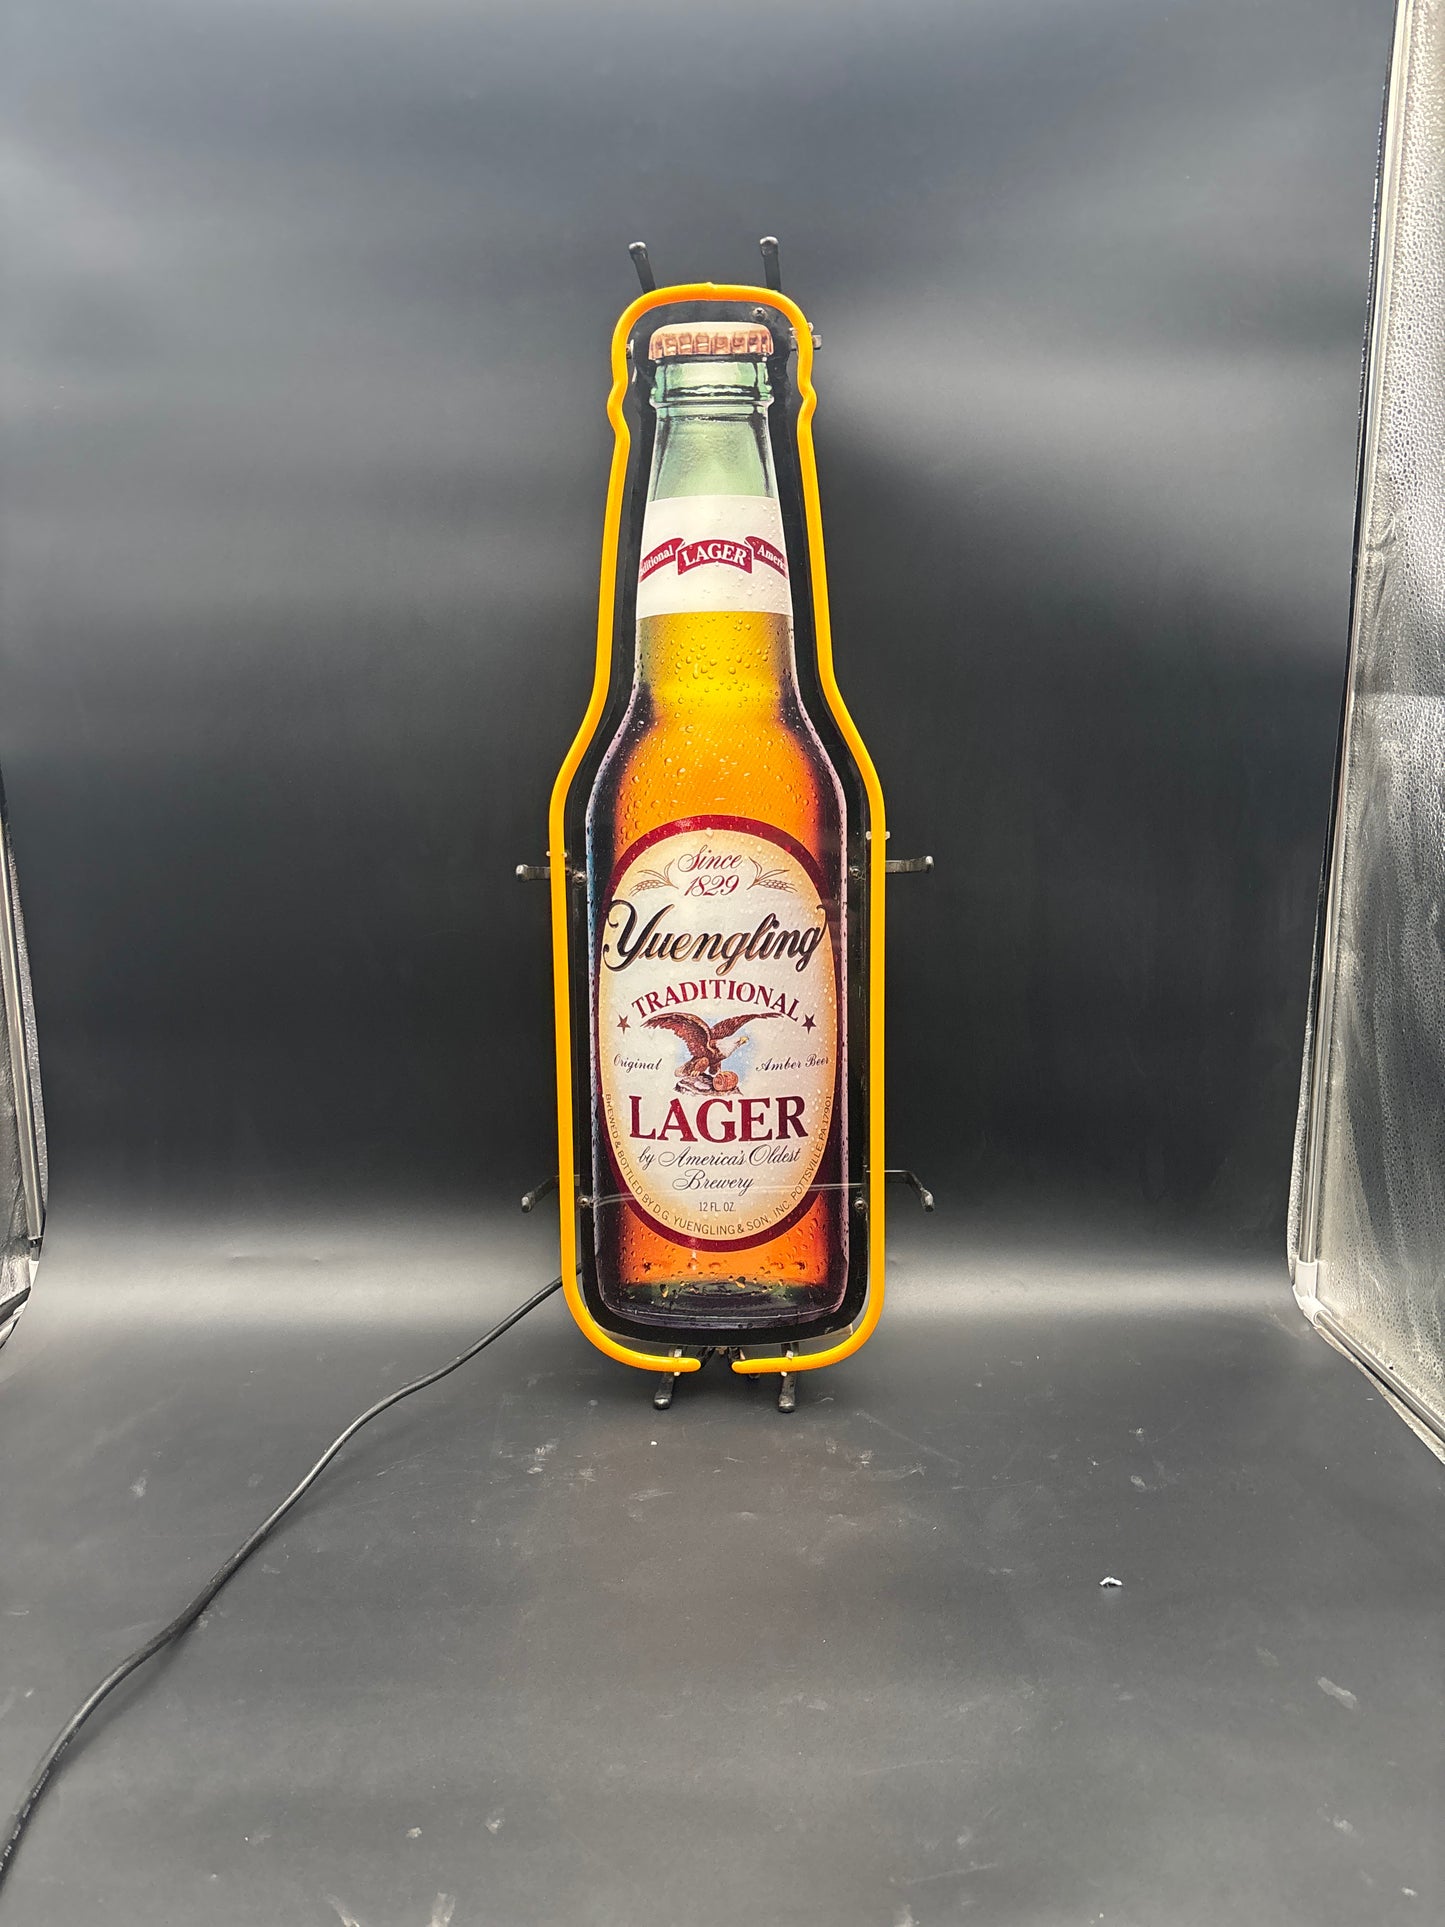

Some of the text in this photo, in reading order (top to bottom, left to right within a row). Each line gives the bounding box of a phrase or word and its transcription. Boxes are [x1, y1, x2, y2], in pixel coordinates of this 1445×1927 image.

[682, 542, 748, 567] LAGER
[677, 844, 744, 873] Since
[683, 874, 740, 897] 1829
[602, 899, 828, 976] Yuengling
[631, 979, 801, 1021] TRADITIONAL
[613, 1053, 830, 1076] Original Amber Beer
[604, 1093, 620, 1140] BREWED
[628, 1094, 809, 1144] LAGER
[822, 1095, 832, 1125] 17901
[614, 1141, 621, 1149] &
[818, 1126, 828, 1142] PA
[637, 1143, 801, 1170] by America's Oldest
[617, 1150, 643, 1196] BOTTLED
[671, 1169, 755, 1196] Brewery
[641, 1194, 655, 1208] BY
[699, 1201, 708, 1212] 12
[673, 1215, 736, 1236] YUENGLING
[737, 1223, 745, 1234] &
[746, 1214, 772, 1231] SON,
